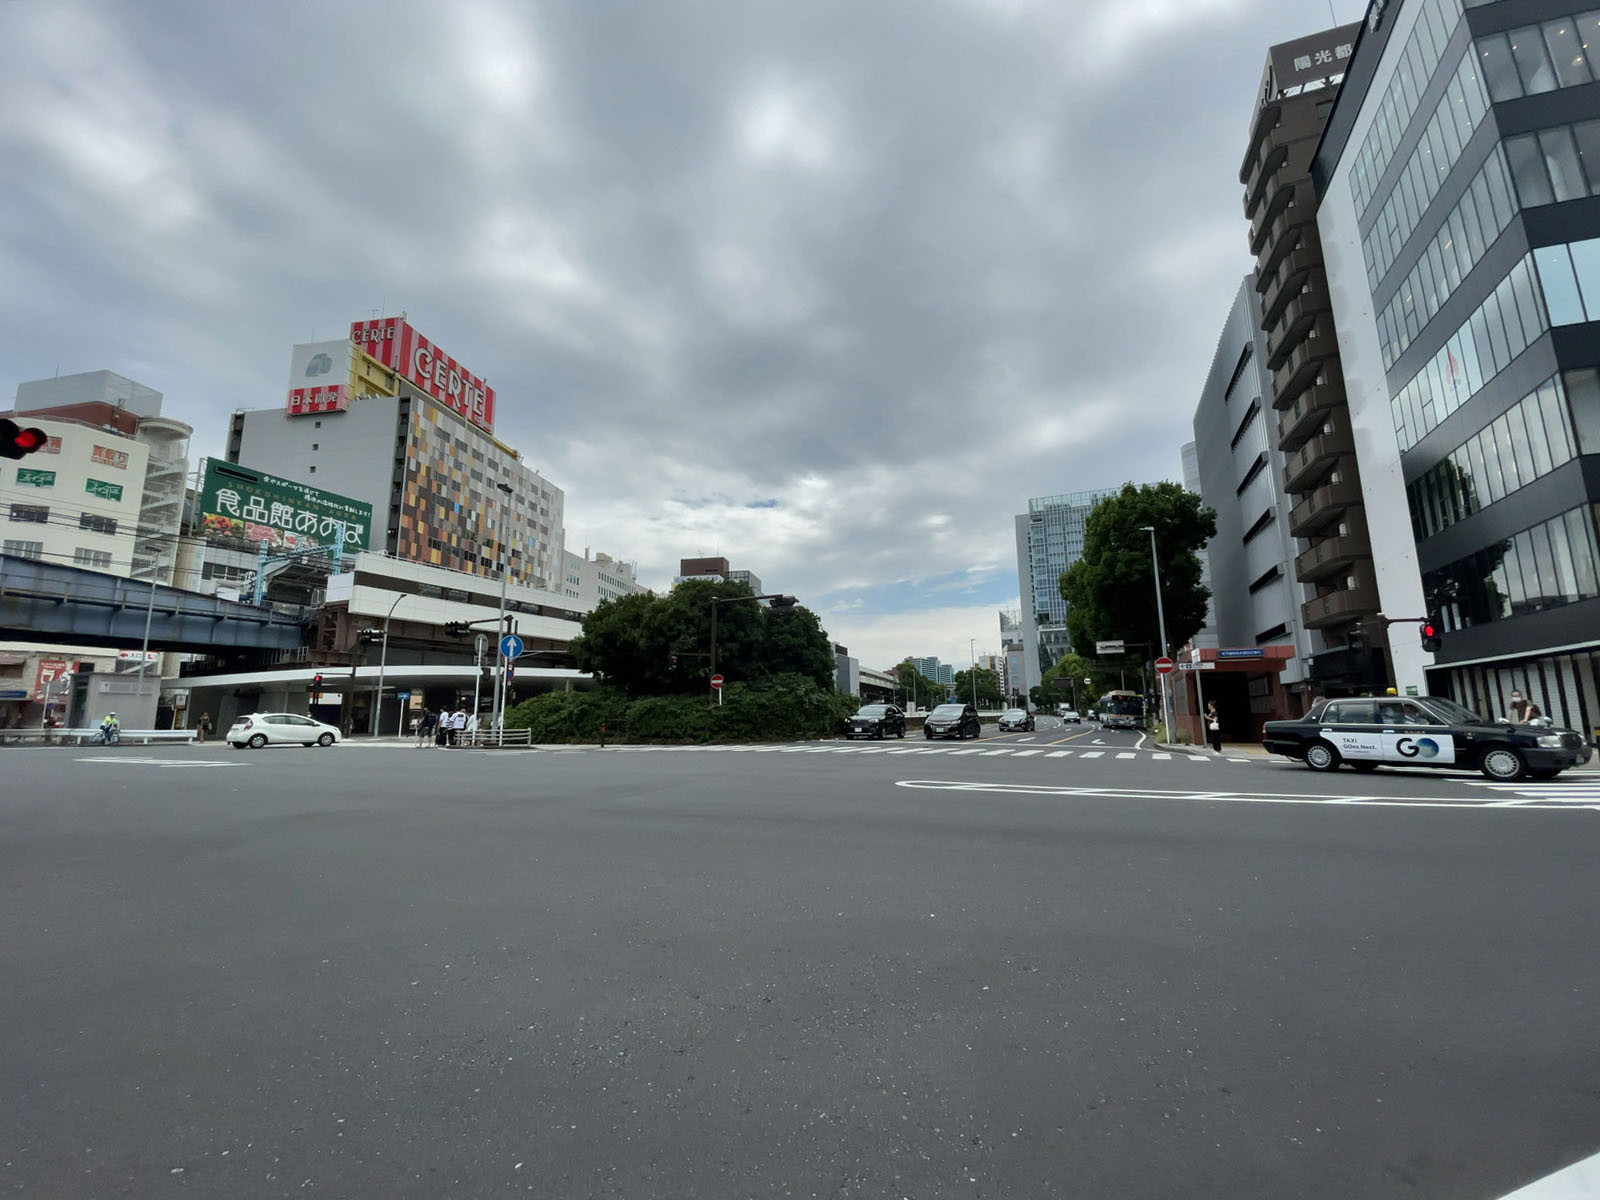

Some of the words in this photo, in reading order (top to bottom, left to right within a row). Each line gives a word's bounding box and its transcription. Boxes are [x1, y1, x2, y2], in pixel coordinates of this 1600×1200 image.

[351, 326, 395, 344] CERTE
[414, 346, 485, 416] CERTE
[215, 487, 365, 545] 食品館あおば
